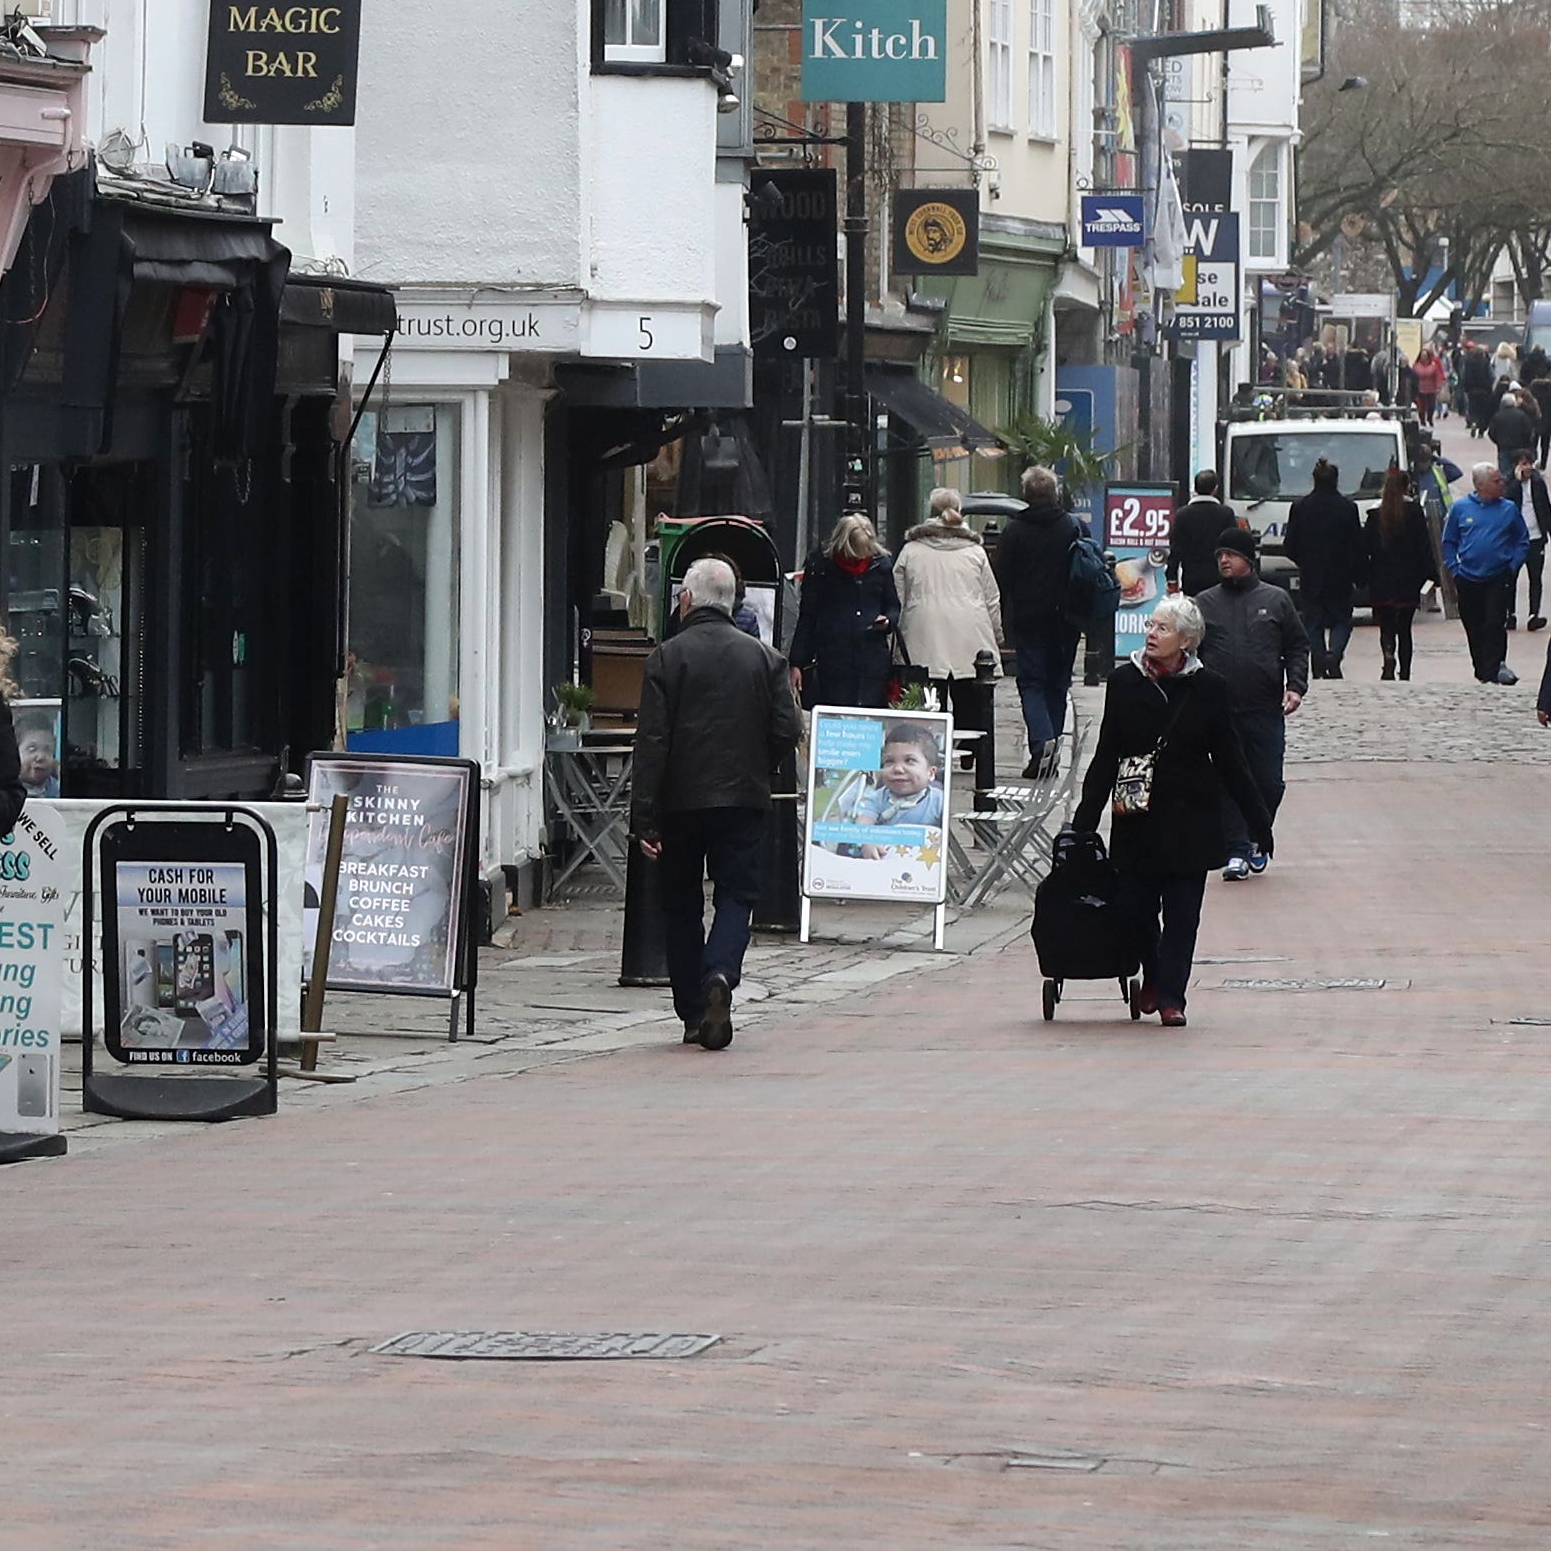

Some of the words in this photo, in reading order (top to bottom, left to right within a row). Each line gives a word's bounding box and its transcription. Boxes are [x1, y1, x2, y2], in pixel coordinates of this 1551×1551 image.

[227, 5, 341, 35] MAGIC
[808, 17, 938, 60] Kitch
[245, 50, 318, 79] BAR
[1084, 221, 1142, 234] TRESPASS
[1179, 317, 1201, 328] 851
[1204, 317, 1234, 329] 2100
[638, 316, 654, 350] 5
[1109, 497, 1171, 538] £2.95
[375, 784, 400, 794] THE
[353, 796, 420, 811] SKINNY
[346, 812, 425, 826] KITCHEN
[18, 811, 37, 834] WE
[32, 830, 60, 861] SELL
[149, 868, 183, 884] CASH
[190, 869, 214, 885] FOR
[339, 861, 429, 878] BREAKFAST
[349, 879, 414, 895] BRUNCH
[137, 888, 172, 904] YOUR
[178, 888, 227, 904] MOBILE
[349, 896, 411, 912] COFFEE
[352, 913, 404, 929] CAKES
[332, 929, 421, 947] COCKTAILS
[149, 1051, 160, 1061] US
[192, 1051, 241, 1063] facebook
